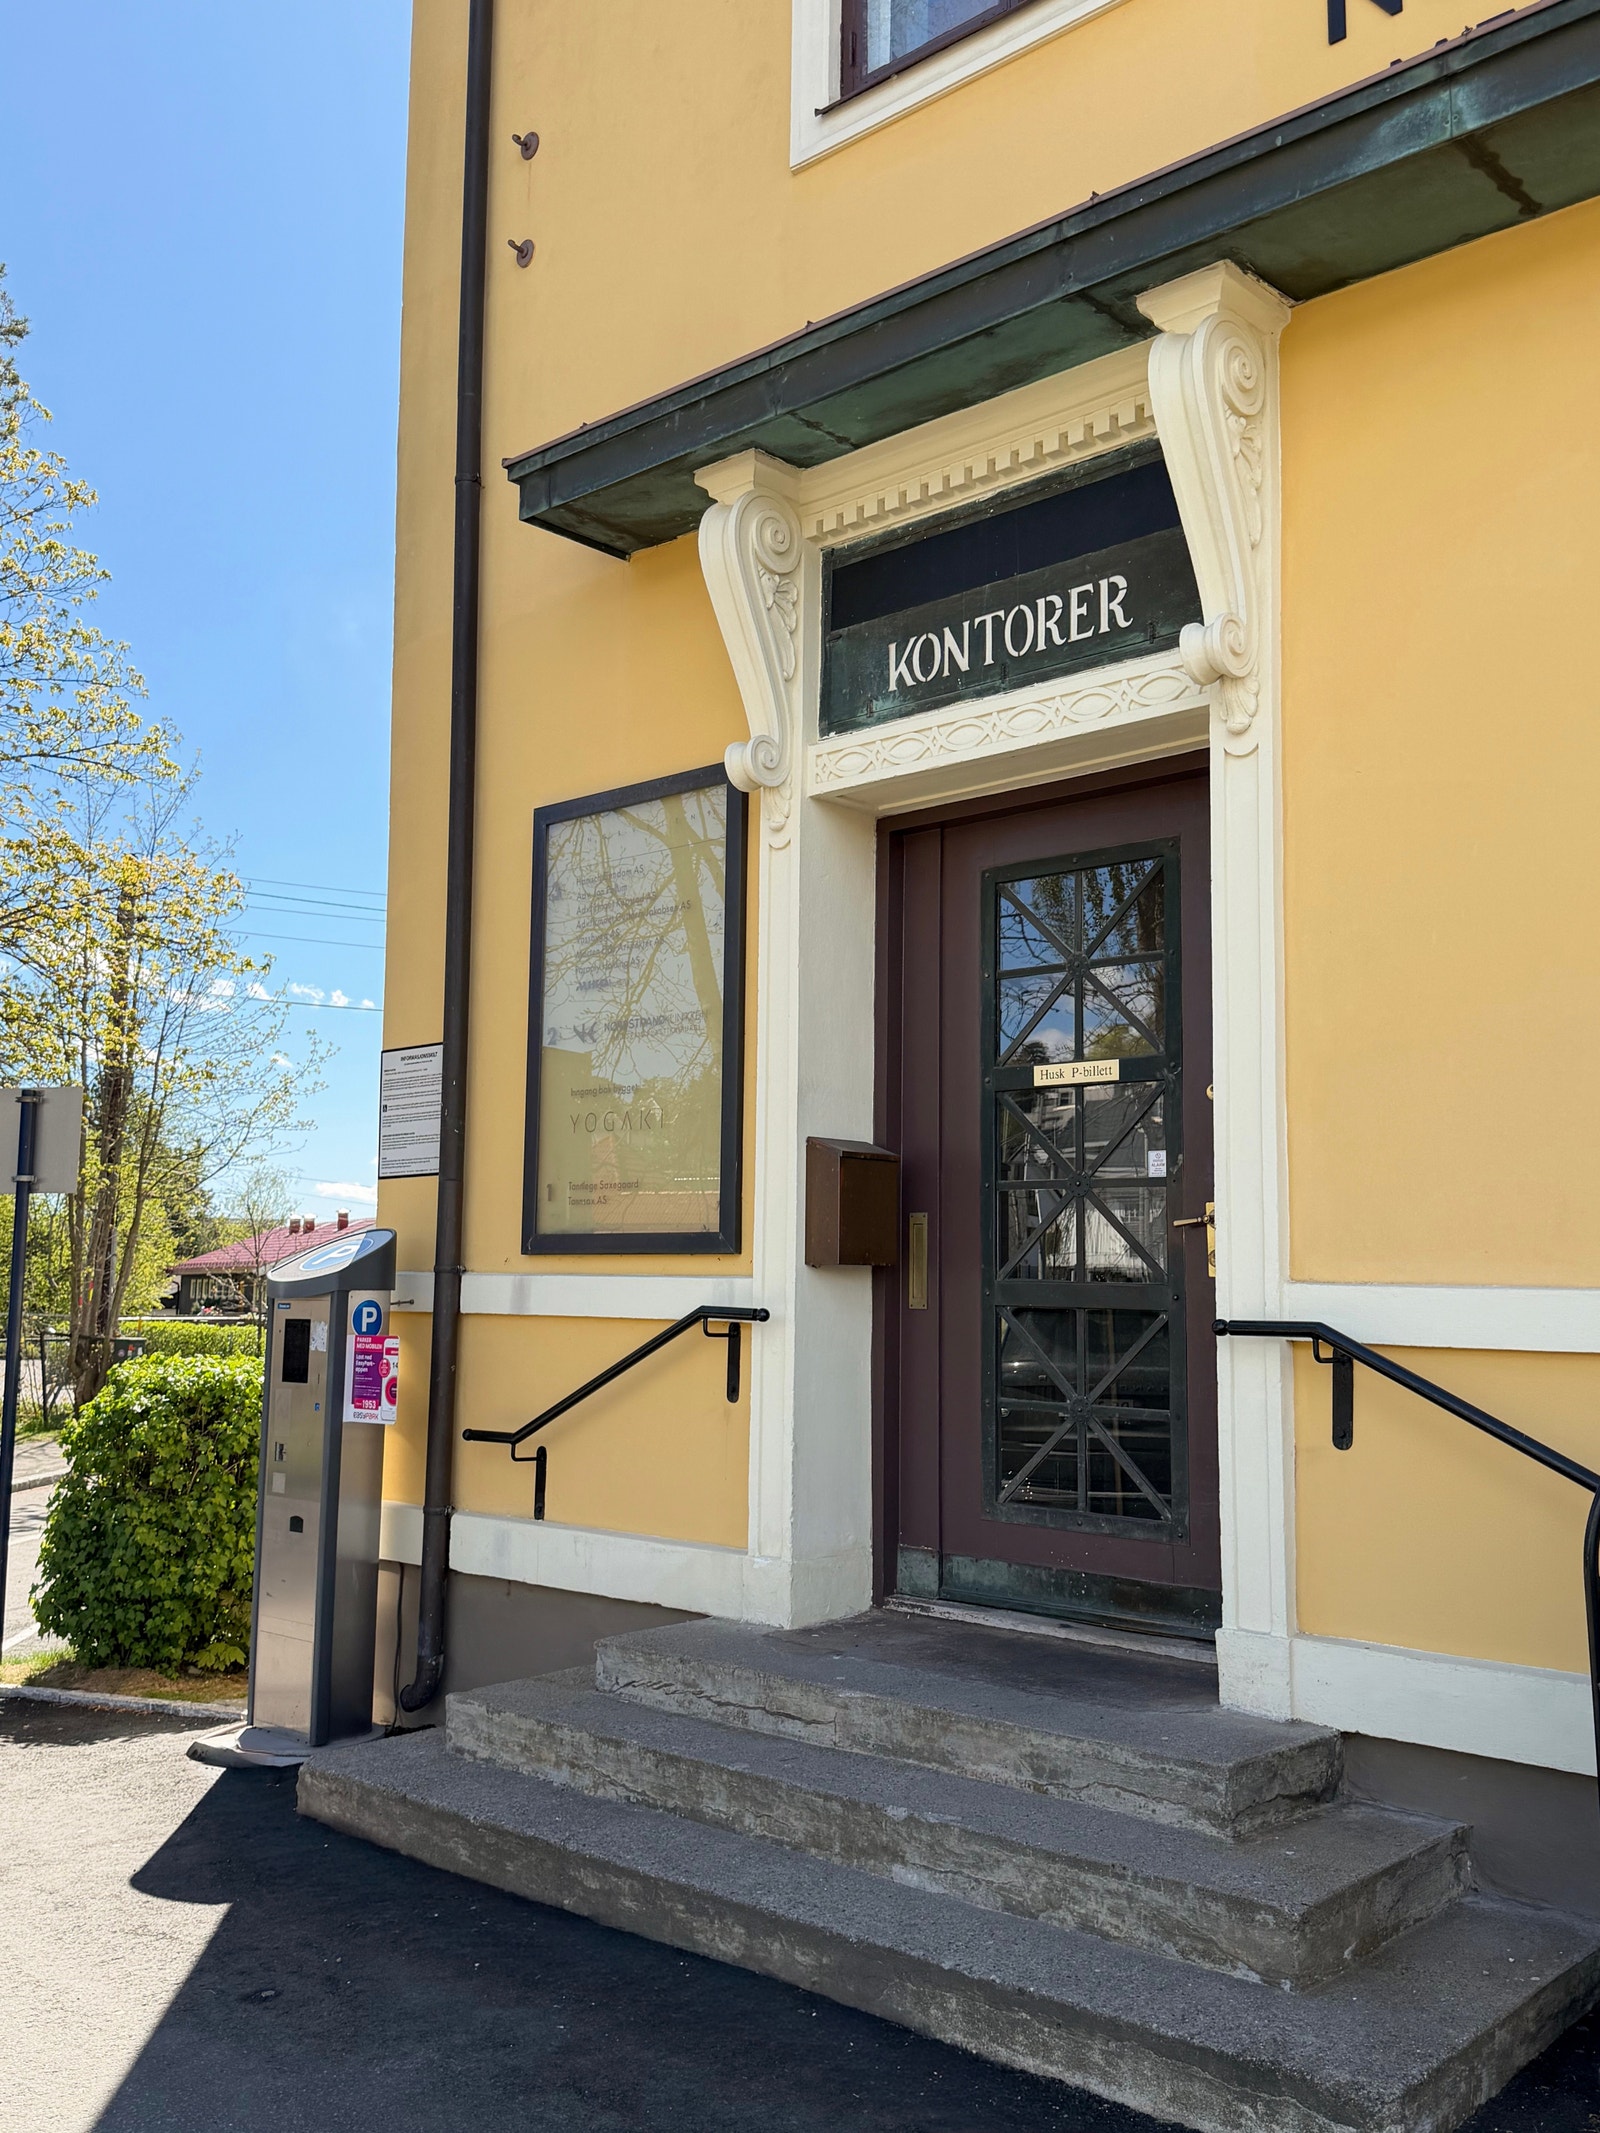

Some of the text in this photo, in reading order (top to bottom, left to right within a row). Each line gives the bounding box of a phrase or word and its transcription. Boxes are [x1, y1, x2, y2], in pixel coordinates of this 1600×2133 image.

[888, 575, 1134, 692] KONTORER
[1040, 1065, 1112, 1080] Husk P-billett
[597, 1195, 608, 1205] AS
[361, 1306, 378, 1332] P
[362, 1400, 377, 1409] 1953
